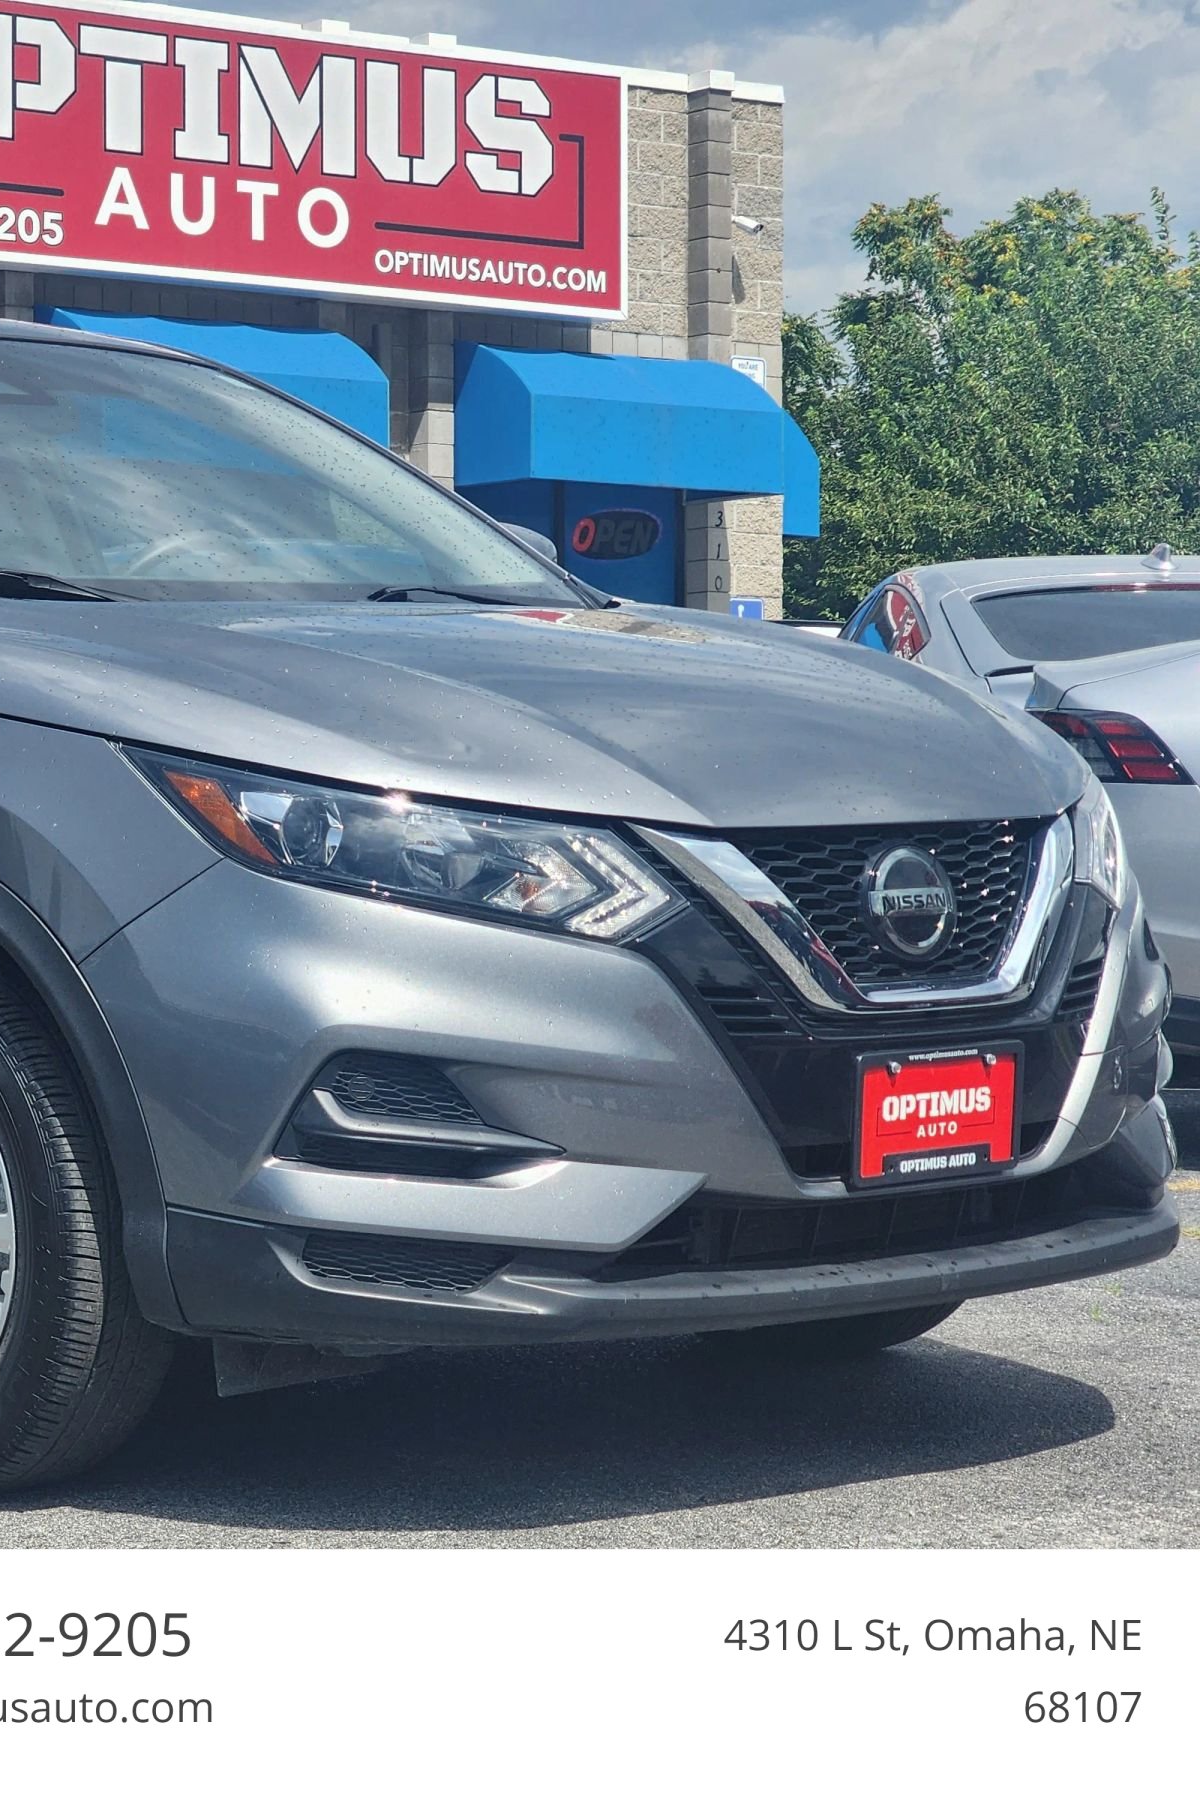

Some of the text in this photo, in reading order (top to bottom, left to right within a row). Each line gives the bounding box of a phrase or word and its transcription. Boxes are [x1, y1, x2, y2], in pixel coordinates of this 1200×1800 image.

[95, 166, 351, 249] AUTO
[374, 249, 608, 294] OPTIMUSAUTO.COM
[572, 517, 650, 553] OPEN
[882, 893, 946, 911] NISSAN
[908, 1048, 978, 1062] www.optimusauto.com
[882, 1086, 991, 1122] OPTIMUS
[916, 1121, 958, 1138] AUTO
[900, 1152, 976, 1174] OPTIMUS AUTO
